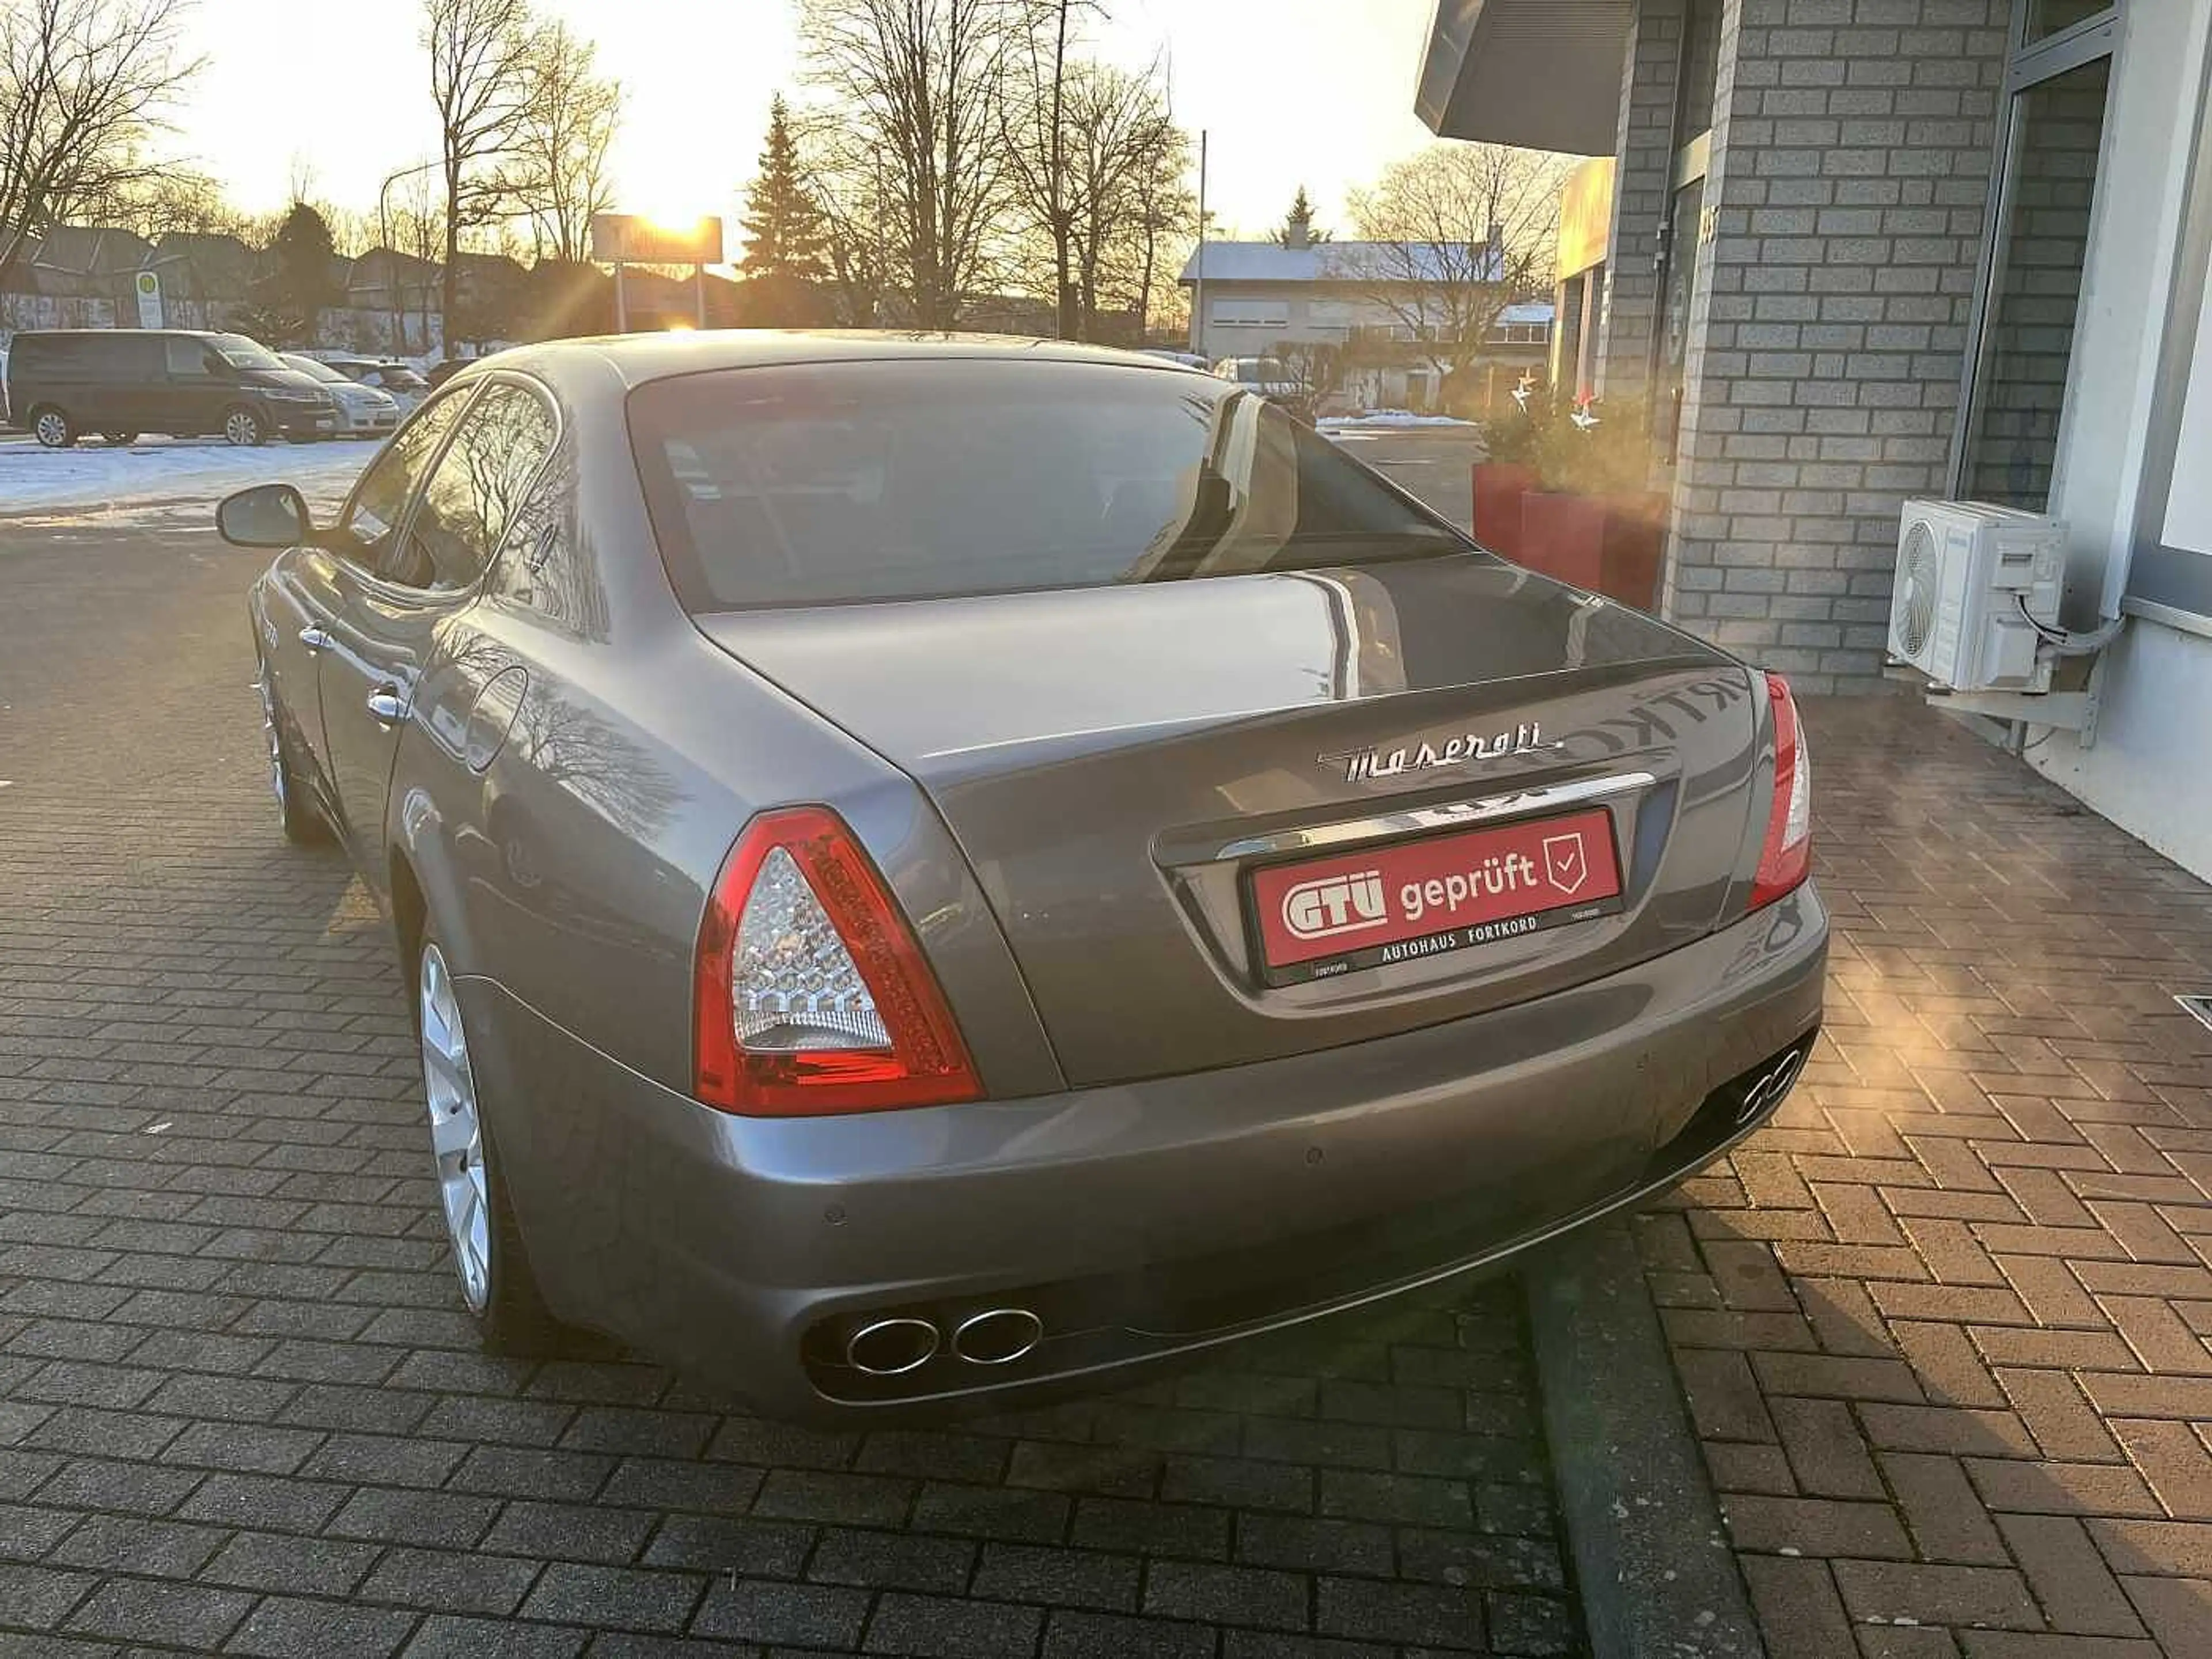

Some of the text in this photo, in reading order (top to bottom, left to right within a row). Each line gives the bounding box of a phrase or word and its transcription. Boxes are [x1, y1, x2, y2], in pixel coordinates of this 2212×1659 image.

[1316, 721, 1565, 783] Maserati
[1285, 853, 1537, 937] GTÜ geprüft
[1382, 916, 1537, 961] AUTOHAUS FORTKORD
